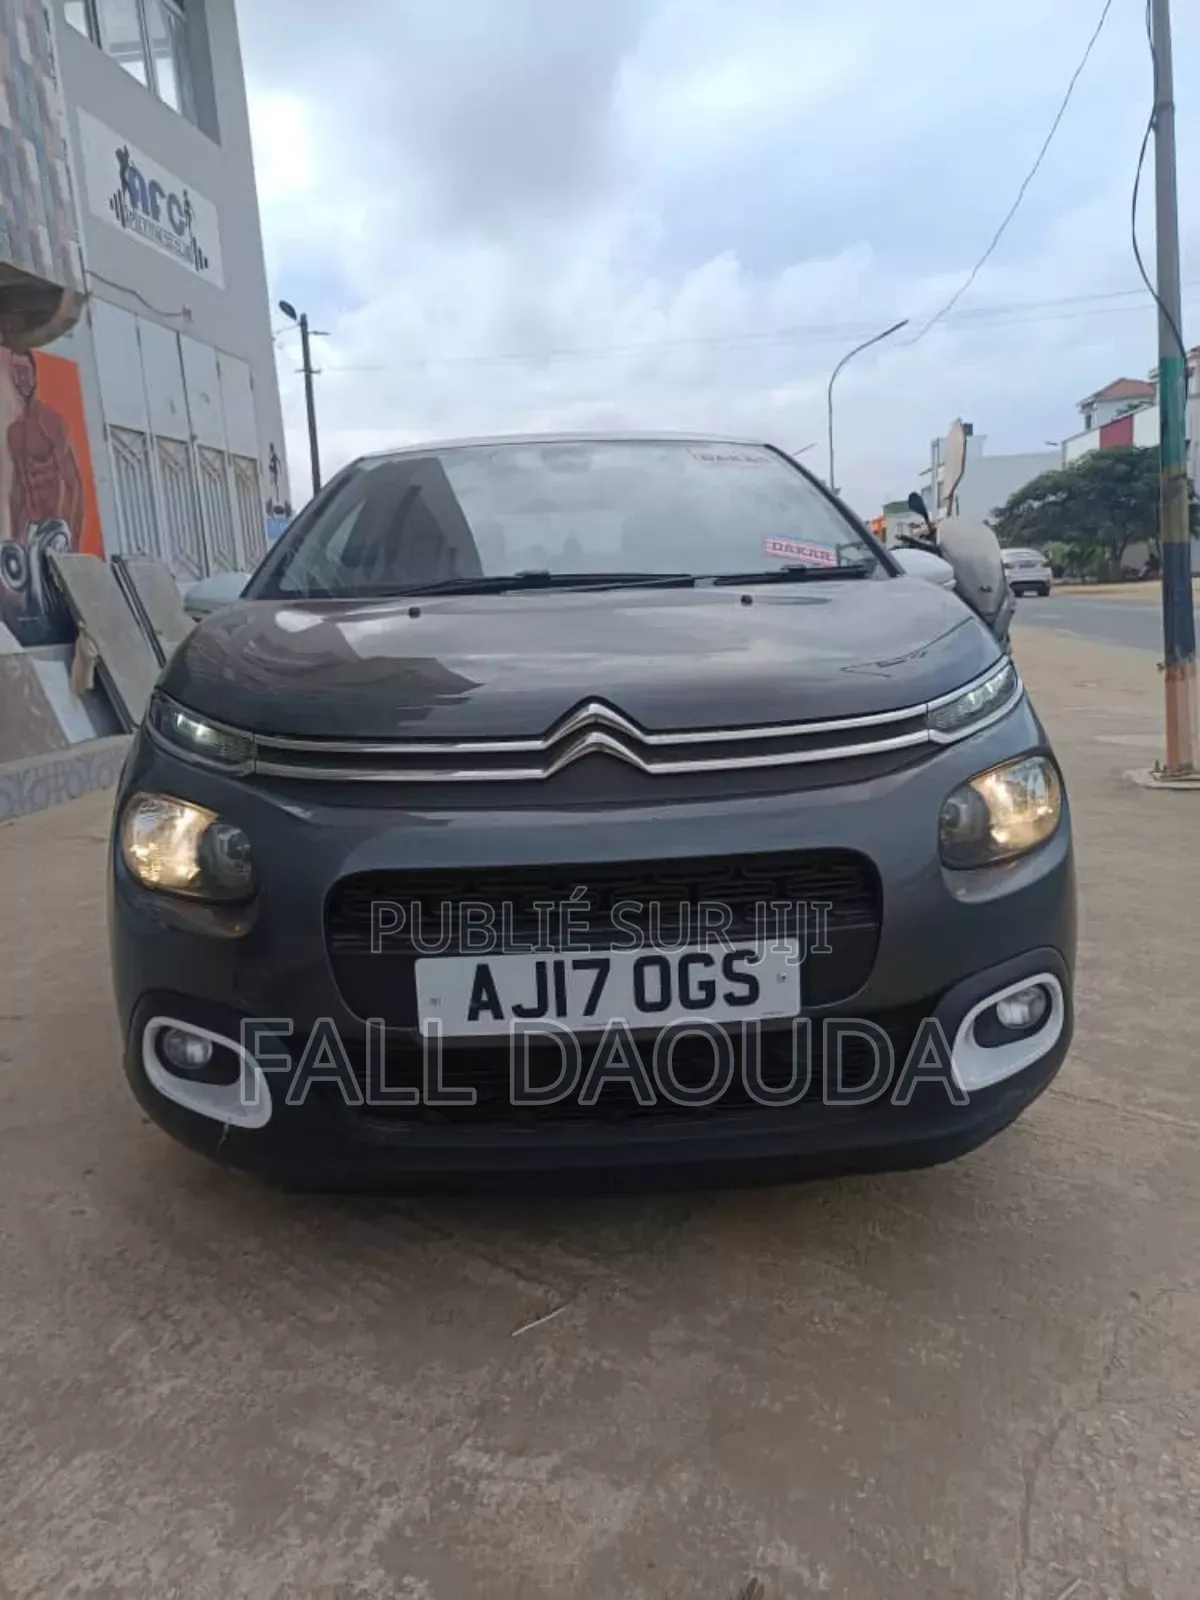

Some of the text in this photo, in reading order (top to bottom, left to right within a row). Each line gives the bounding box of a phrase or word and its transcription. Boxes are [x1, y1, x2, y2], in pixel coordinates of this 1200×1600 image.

[771, 541, 831, 561] DAKAR
[467, 949, 760, 1022] AJ17 OGS
